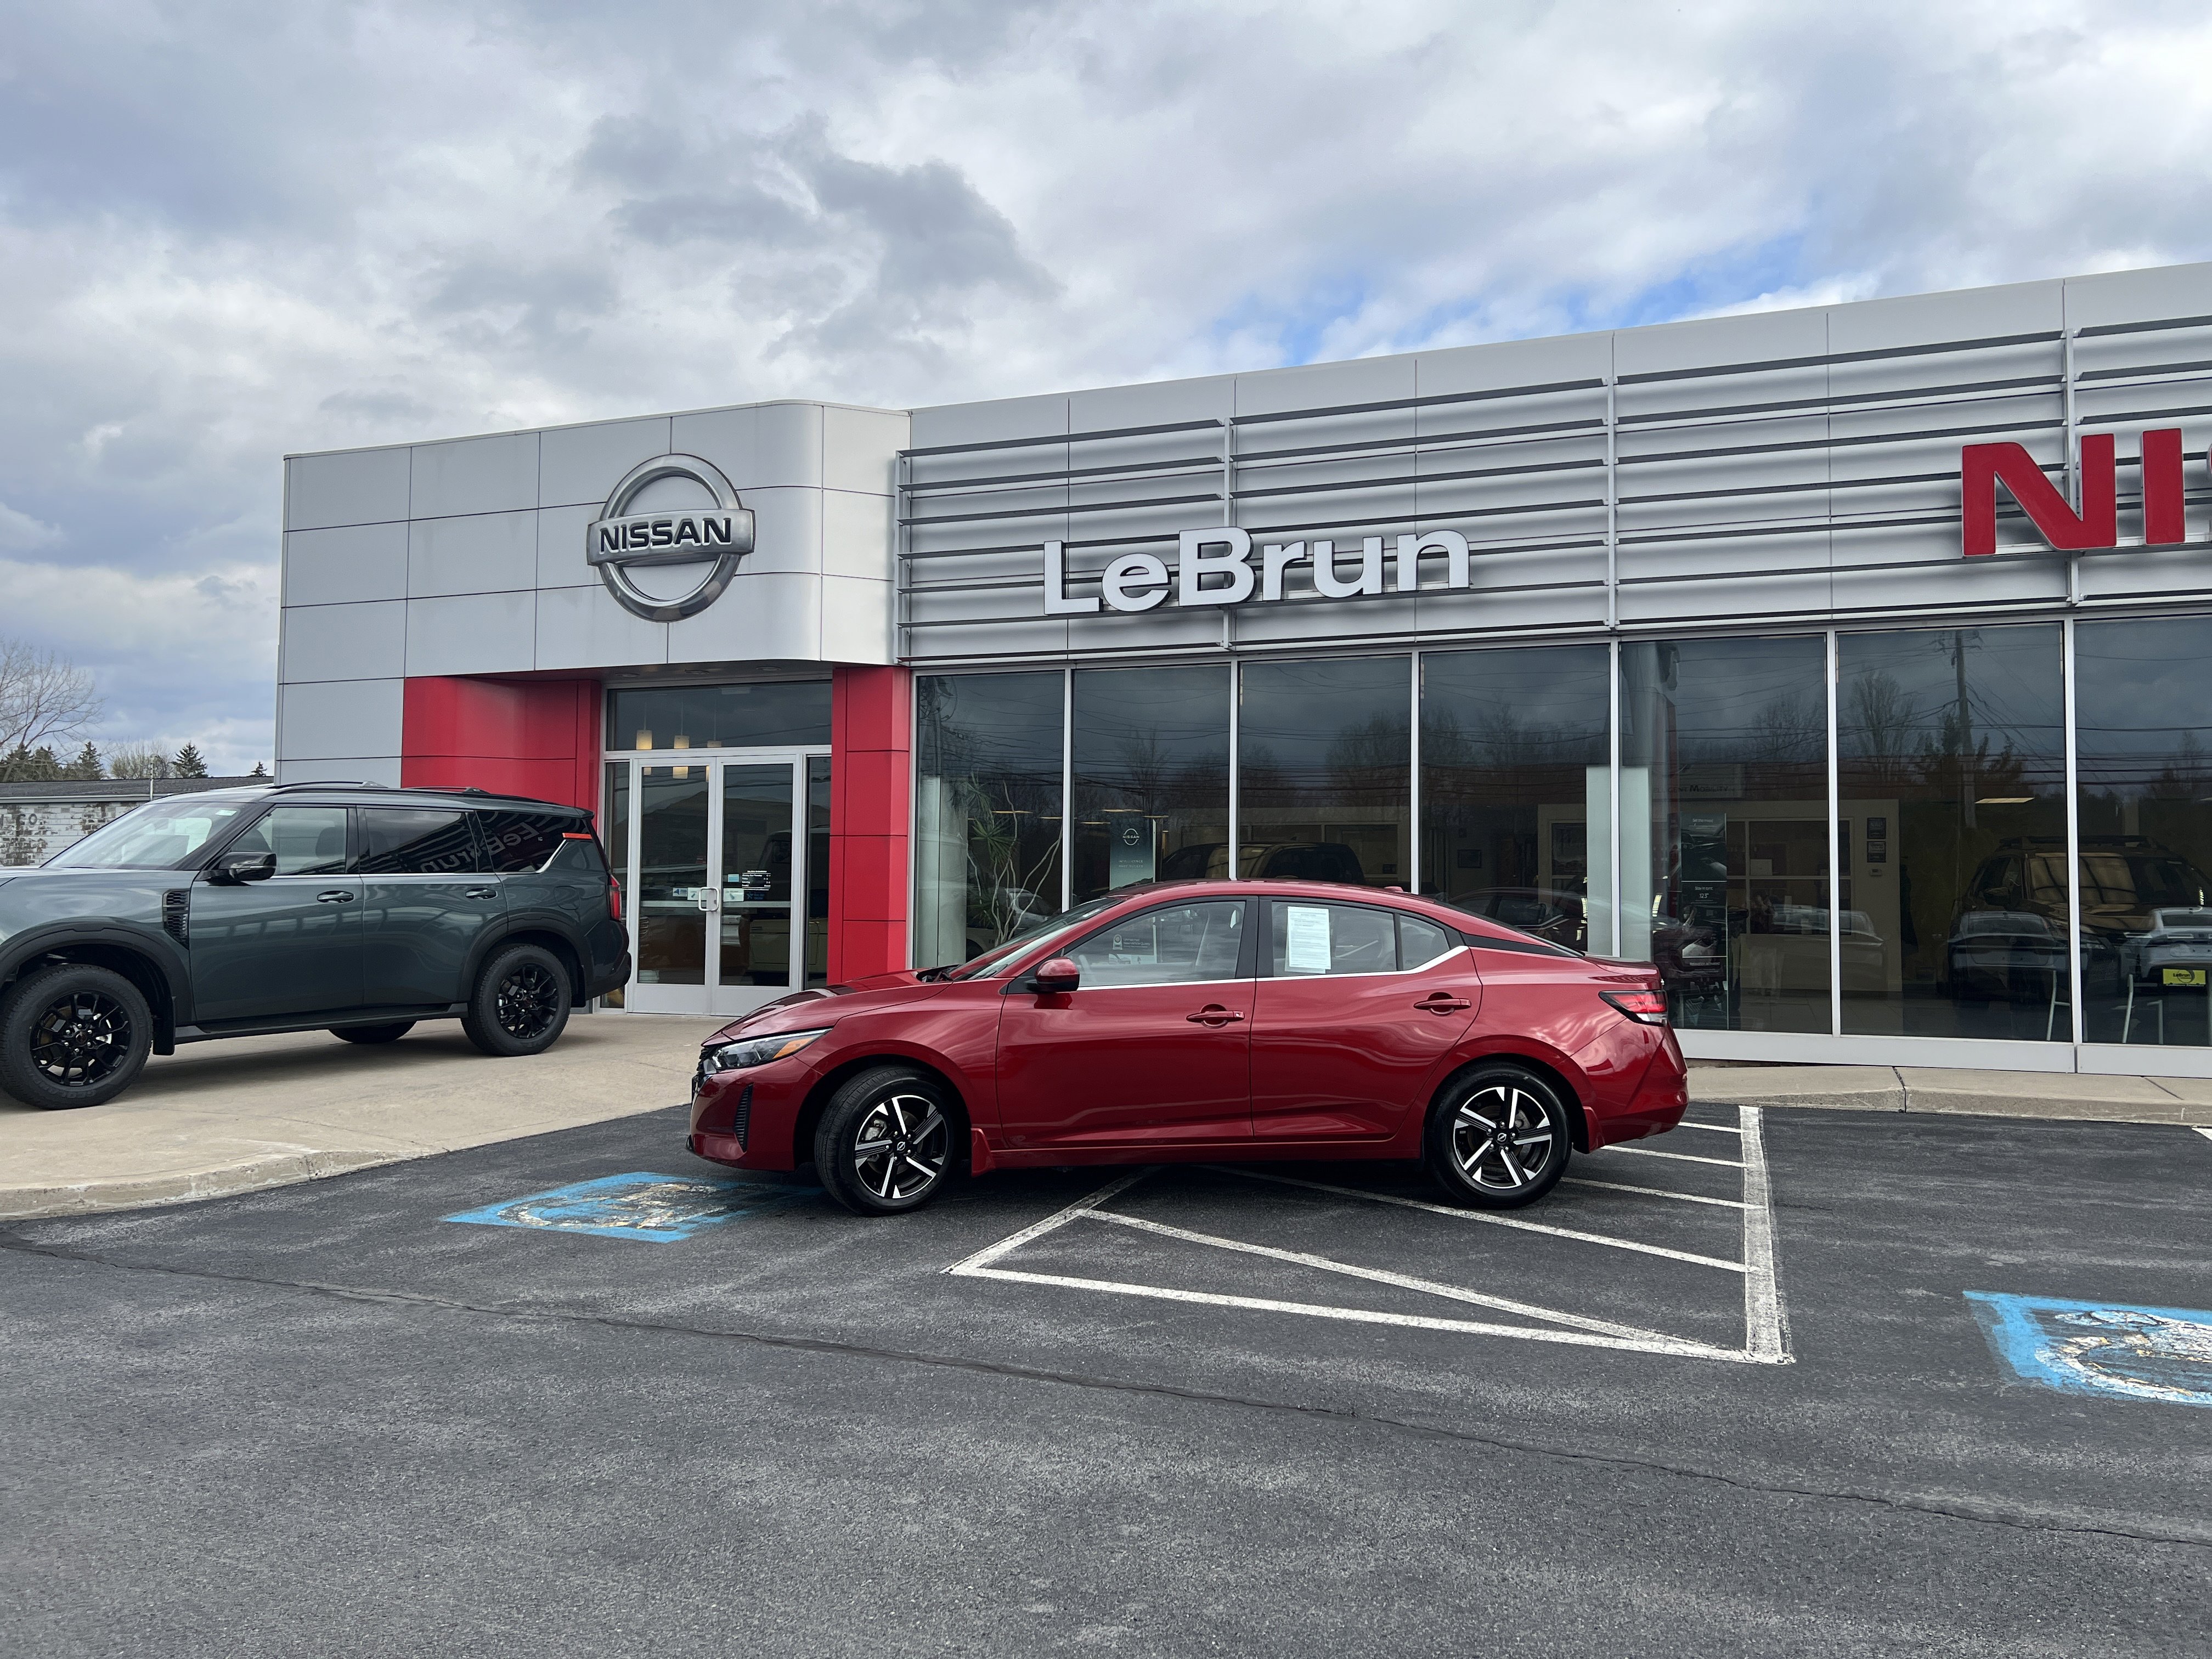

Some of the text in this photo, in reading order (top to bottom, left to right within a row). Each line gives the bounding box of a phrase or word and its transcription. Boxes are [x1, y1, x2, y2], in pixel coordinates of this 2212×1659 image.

[600, 517, 732, 554] NISSAN
[1961, 428, 2212, 557] NI
[1043, 527, 1472, 616] LeBrun
